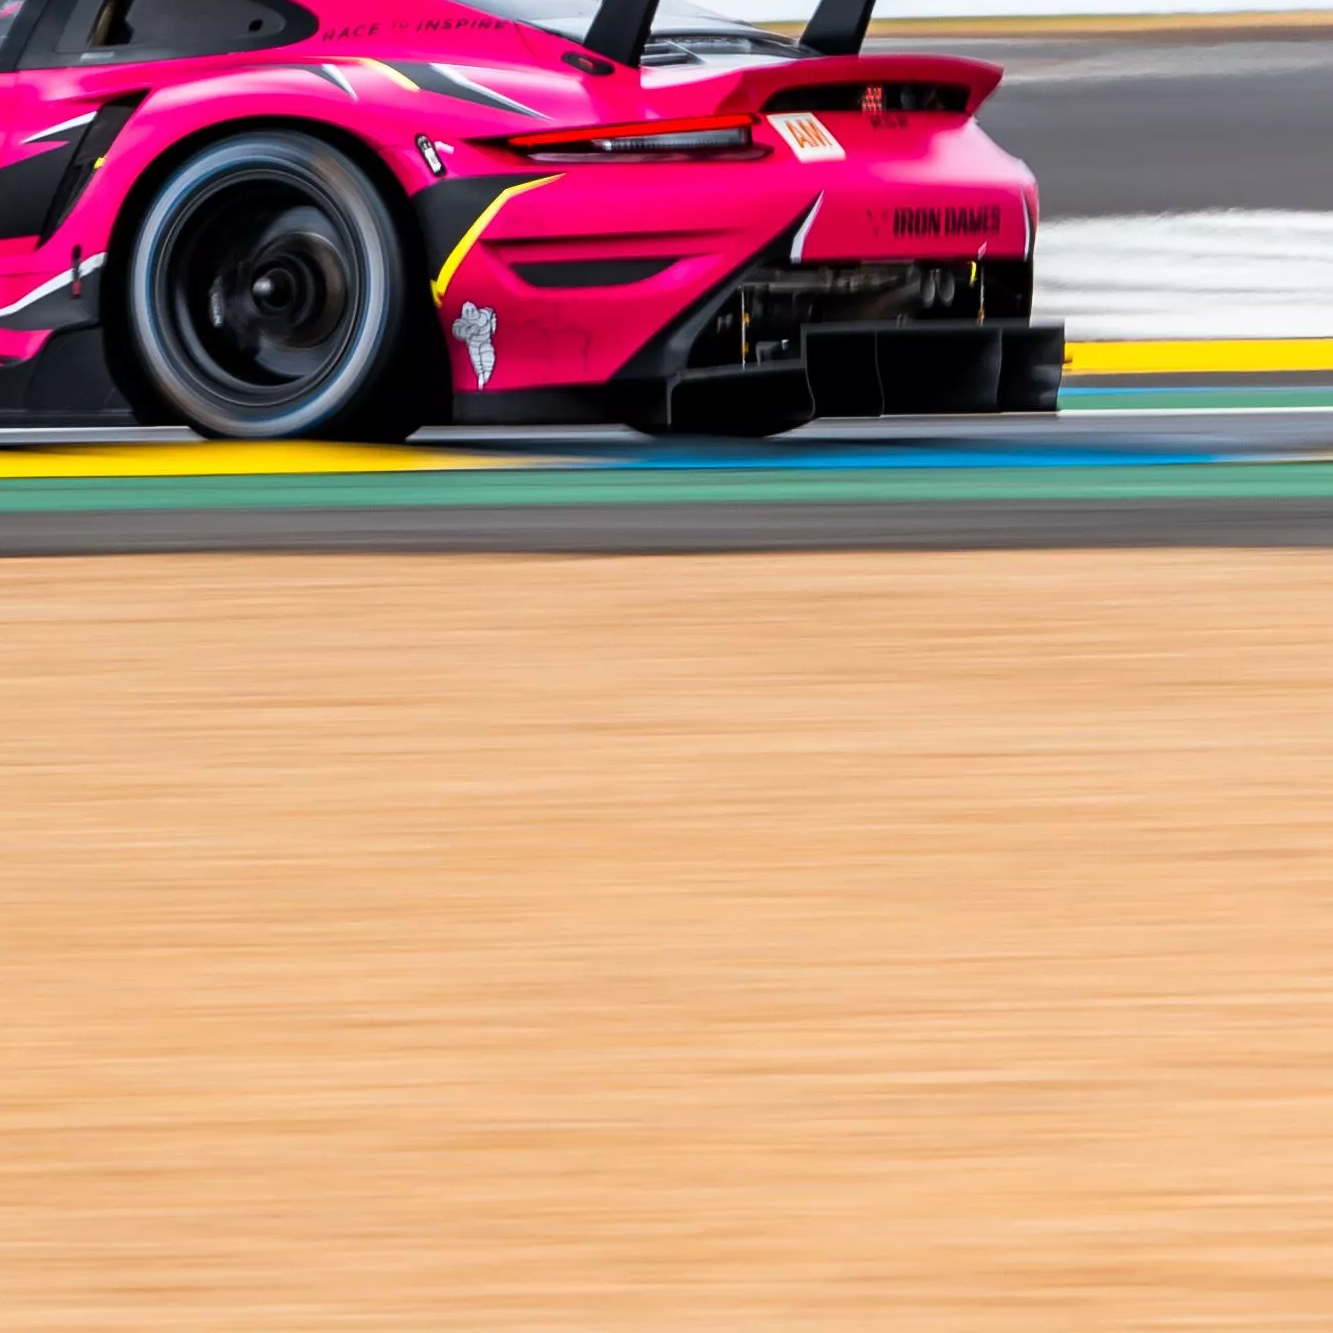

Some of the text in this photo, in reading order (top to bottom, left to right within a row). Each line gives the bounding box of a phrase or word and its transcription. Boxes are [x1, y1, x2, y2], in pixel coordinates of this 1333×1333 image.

[321, 21, 381, 42] RACE
[416, 18, 507, 33] INSPIRE
[784, 117, 832, 149] AM
[892, 204, 1002, 238] IRON DAMES
